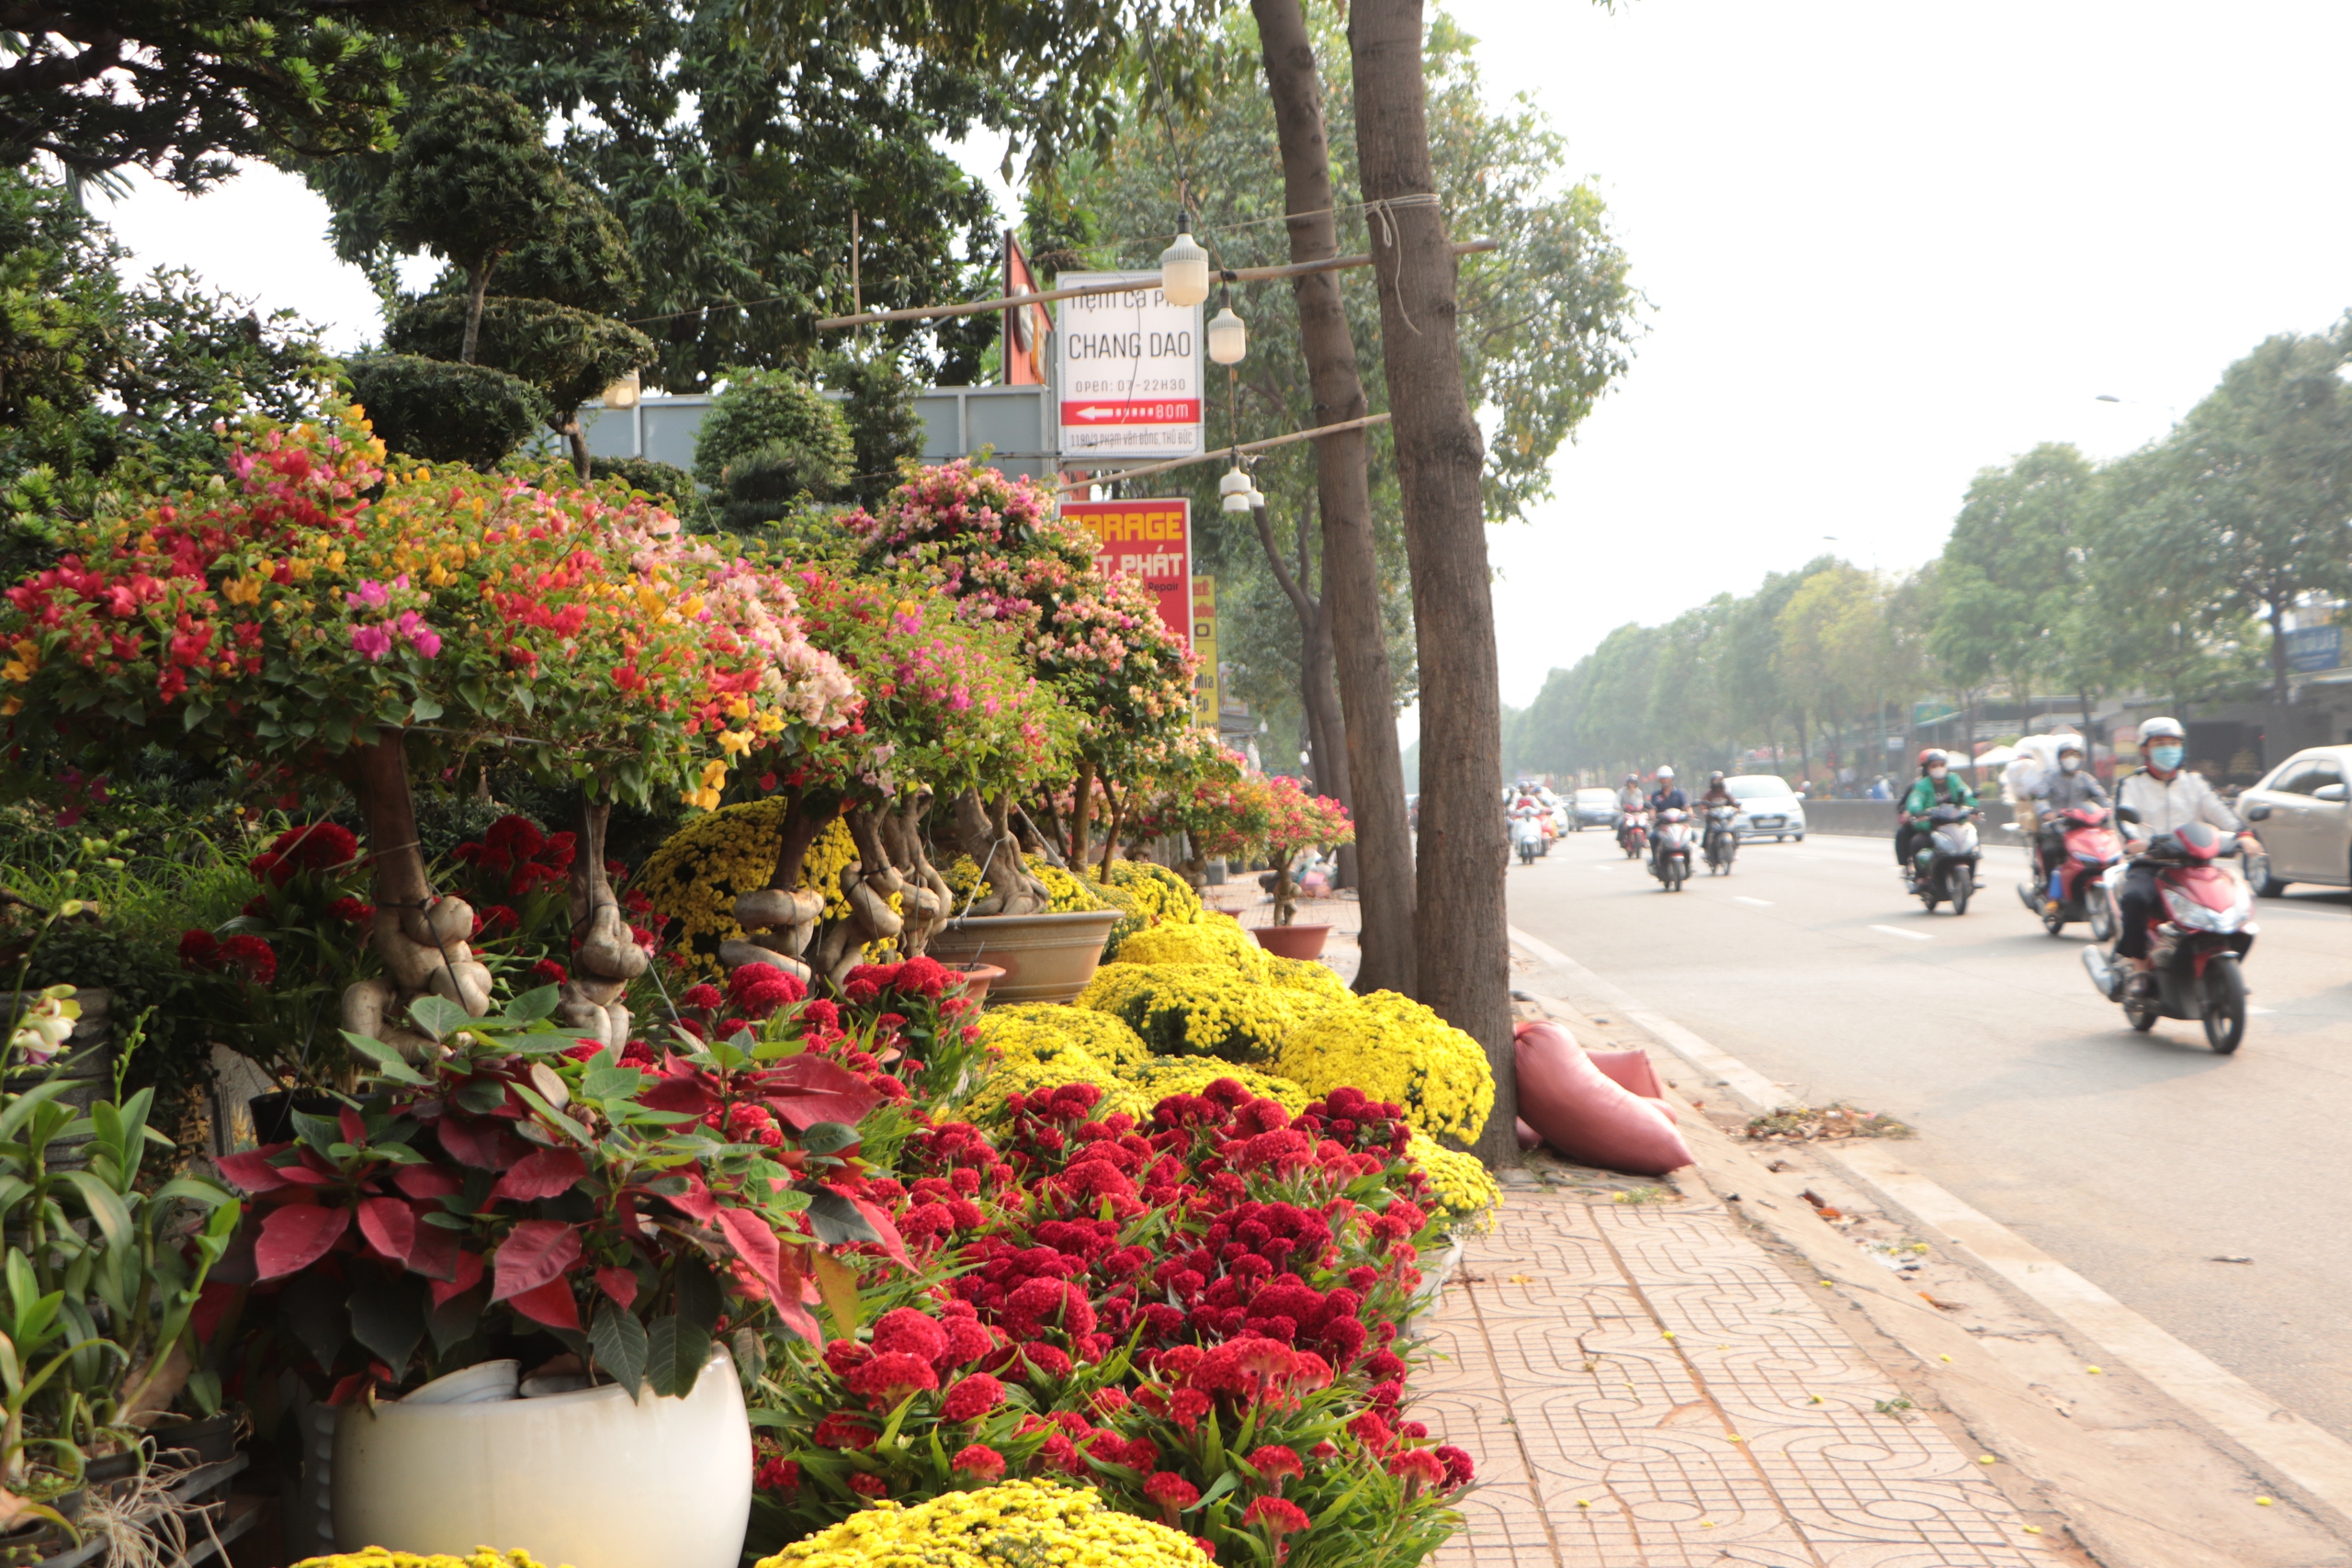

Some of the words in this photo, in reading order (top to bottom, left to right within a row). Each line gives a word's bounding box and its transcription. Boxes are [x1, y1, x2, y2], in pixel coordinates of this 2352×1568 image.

[1069, 333, 1141, 359] CHANG
[1150, 331, 1191, 357] DAO
[1066, 512, 1183, 542] ARAGE
[1120, 544, 1184, 578] PHÁT
[1148, 581, 1179, 593] Repair
